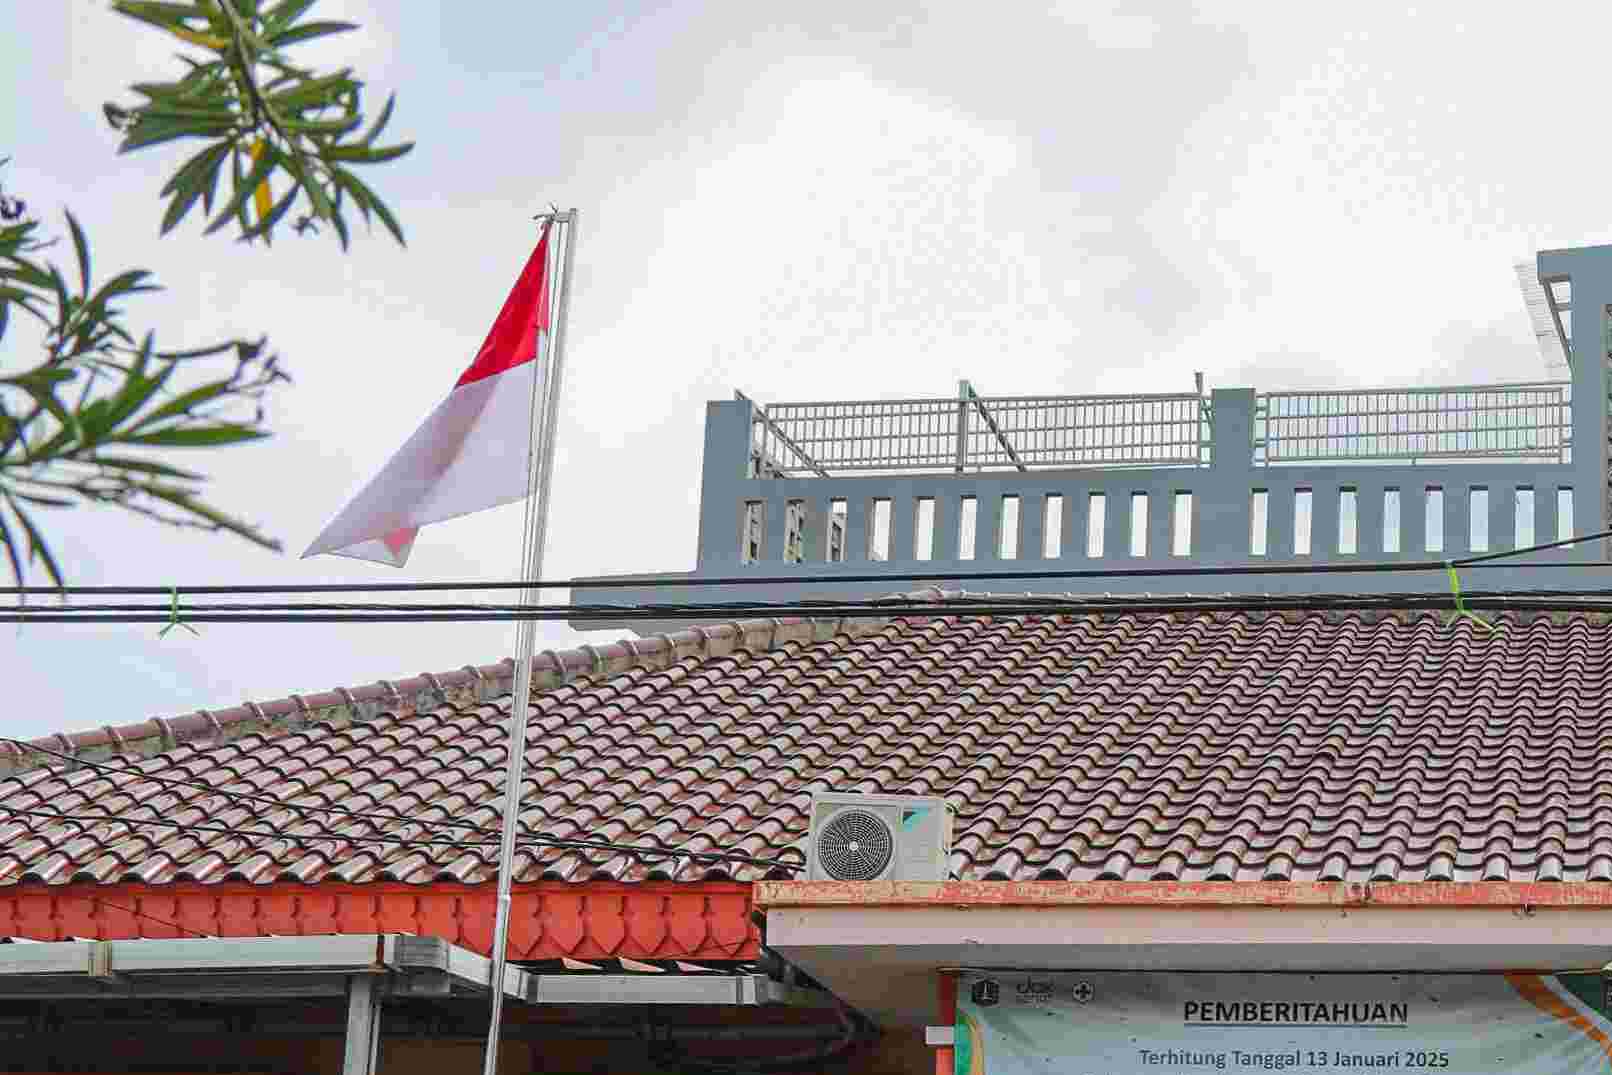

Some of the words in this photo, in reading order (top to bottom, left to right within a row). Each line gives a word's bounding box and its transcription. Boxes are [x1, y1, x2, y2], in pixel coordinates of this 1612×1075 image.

[1184, 1001, 1408, 1023] PEMBERITAHUAN
[1140, 1049, 1226, 1069] Terhitung
[1232, 1050, 1301, 1069] Tanggal
[1307, 1052, 1328, 1067] 13
[1333, 1051, 1399, 1067] Januari
[1405, 1052, 1449, 1067] 2025
